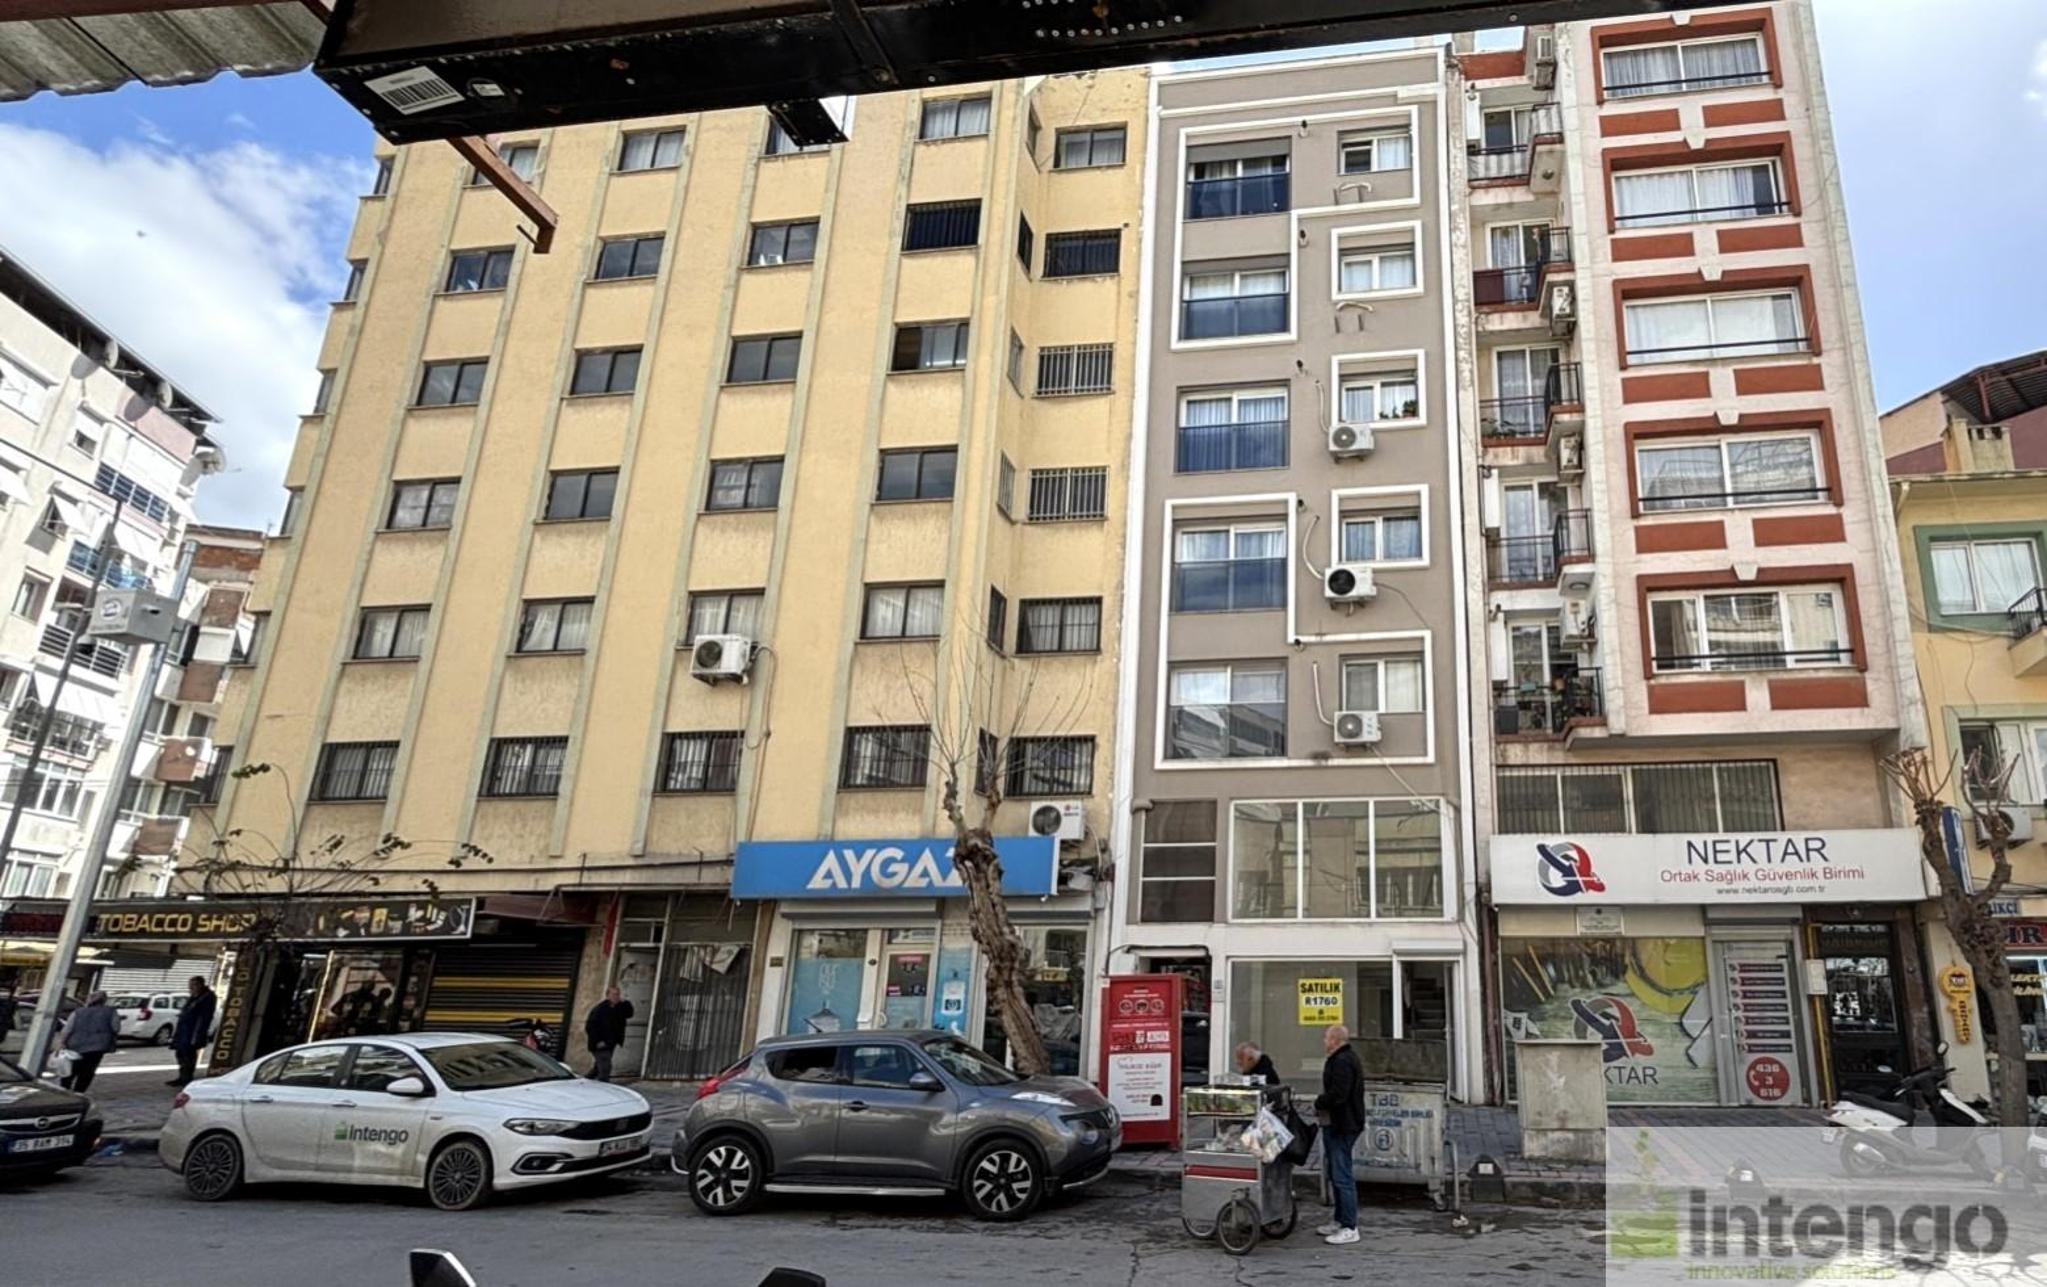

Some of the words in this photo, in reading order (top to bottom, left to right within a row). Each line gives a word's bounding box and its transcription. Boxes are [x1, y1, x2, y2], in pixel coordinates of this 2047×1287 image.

[1686, 837, 1829, 864] NEKTAR
[1660, 869, 1700, 883] Ortak
[1705, 869, 1750, 885] Sağlık
[1755, 867, 1818, 882] Güvenlik
[1823, 867, 1864, 881] Birimi
[96, 914, 192, 932] TOBACCO
[1300, 982, 1341, 994] SATILIK
[1603, 1066, 1659, 1085] KTAR
